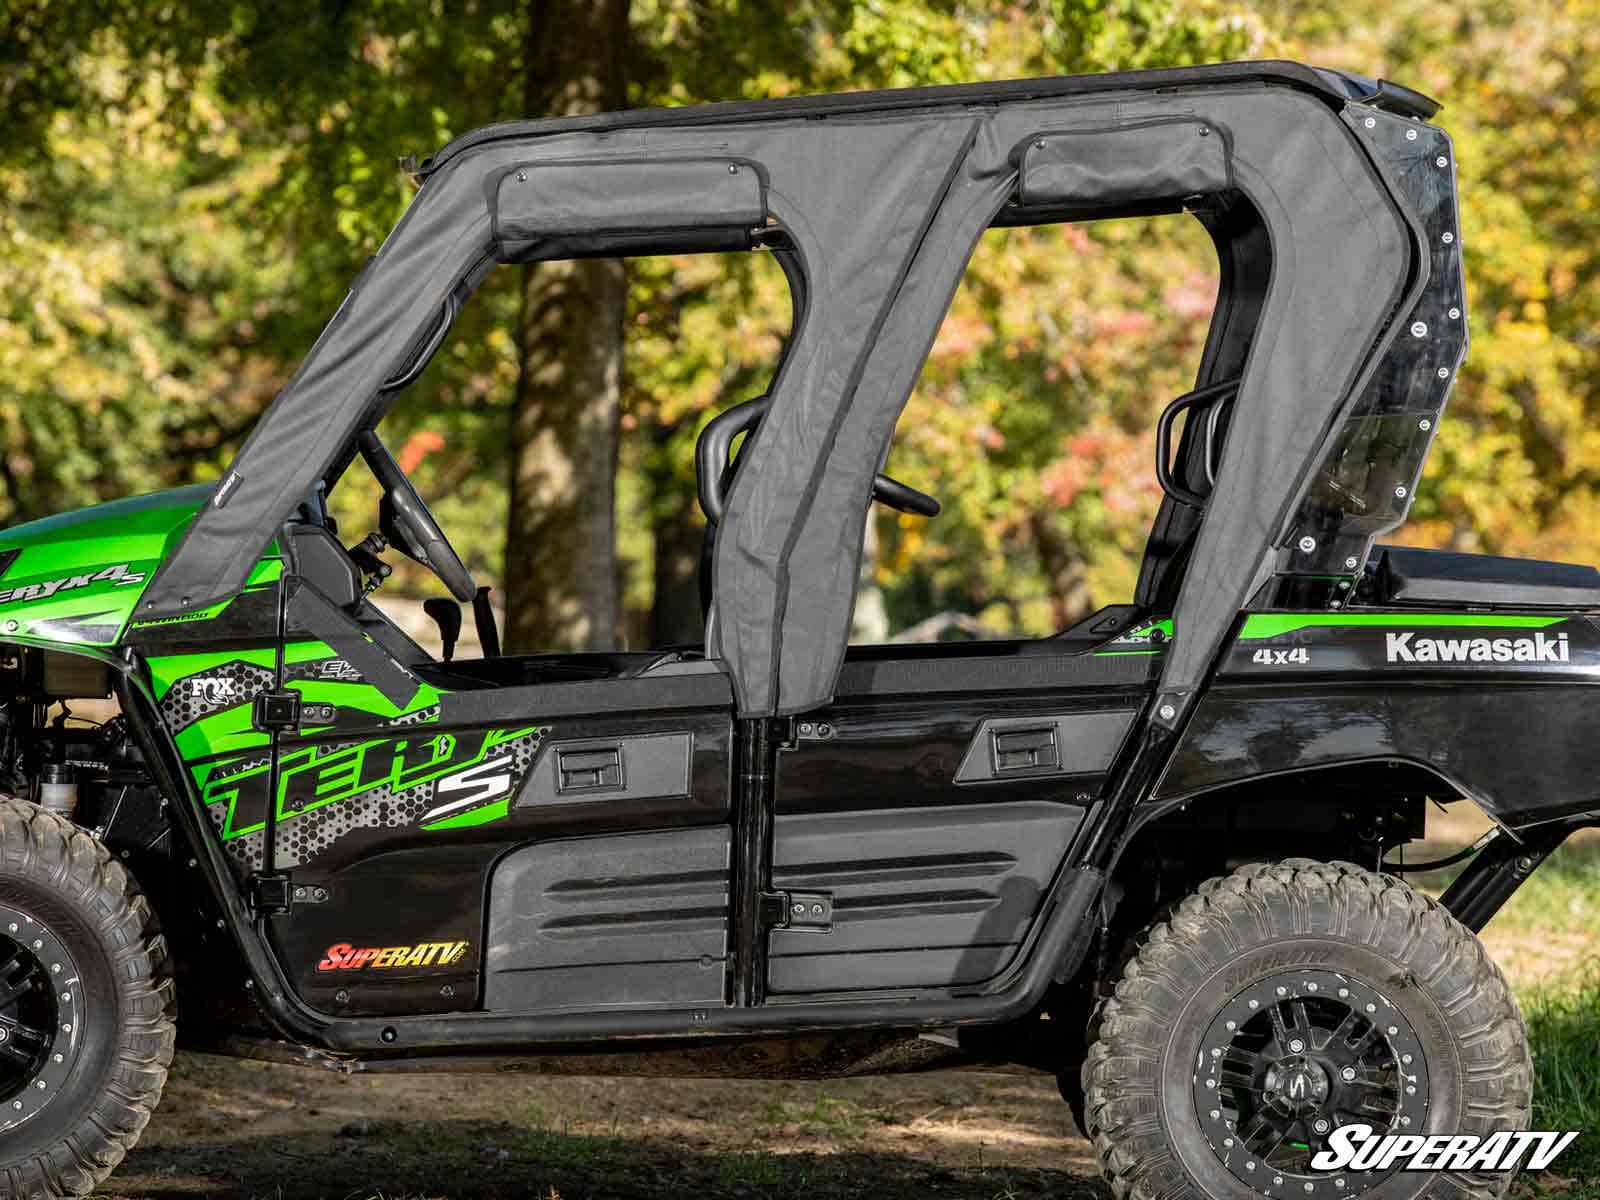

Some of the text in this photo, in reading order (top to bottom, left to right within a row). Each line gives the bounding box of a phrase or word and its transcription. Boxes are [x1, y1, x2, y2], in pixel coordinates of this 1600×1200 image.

[1252, 648, 1309, 665] 4x4
[1386, 632, 1569, 662] Kawasaki
[191, 677, 235, 706] FOX
[318, 941, 465, 972] SUPERATV
